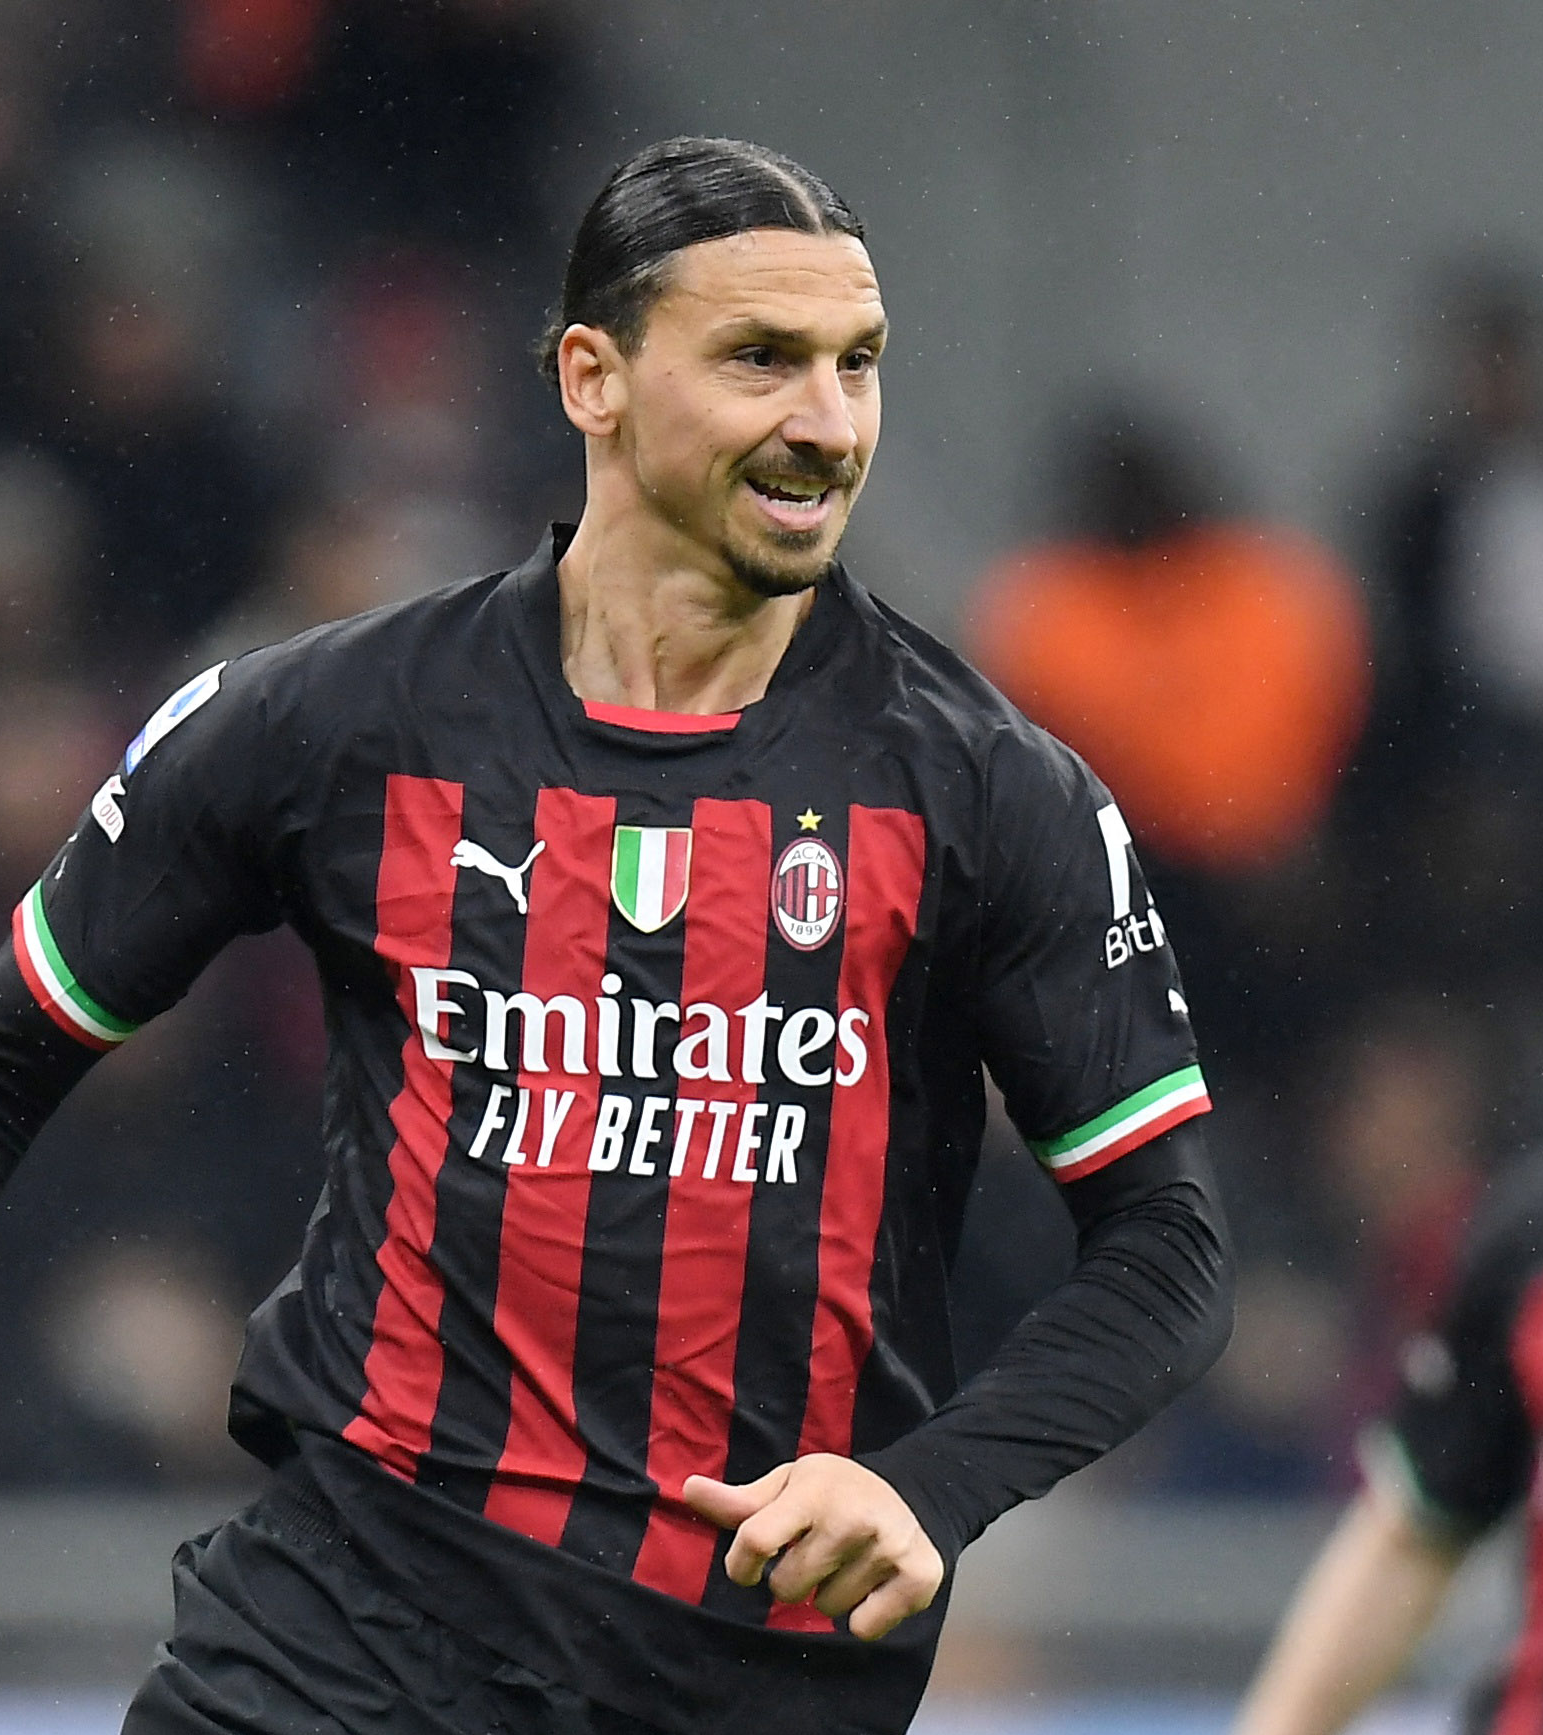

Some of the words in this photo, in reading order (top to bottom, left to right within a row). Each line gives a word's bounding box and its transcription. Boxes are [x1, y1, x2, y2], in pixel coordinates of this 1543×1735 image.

[789, 846, 828, 866] ACM
[790, 923, 823, 936] 1899
[411, 967, 870, 1086] Emirates
[468, 1084, 576, 1167] FLY
[587, 1095, 806, 1183] BETTER
